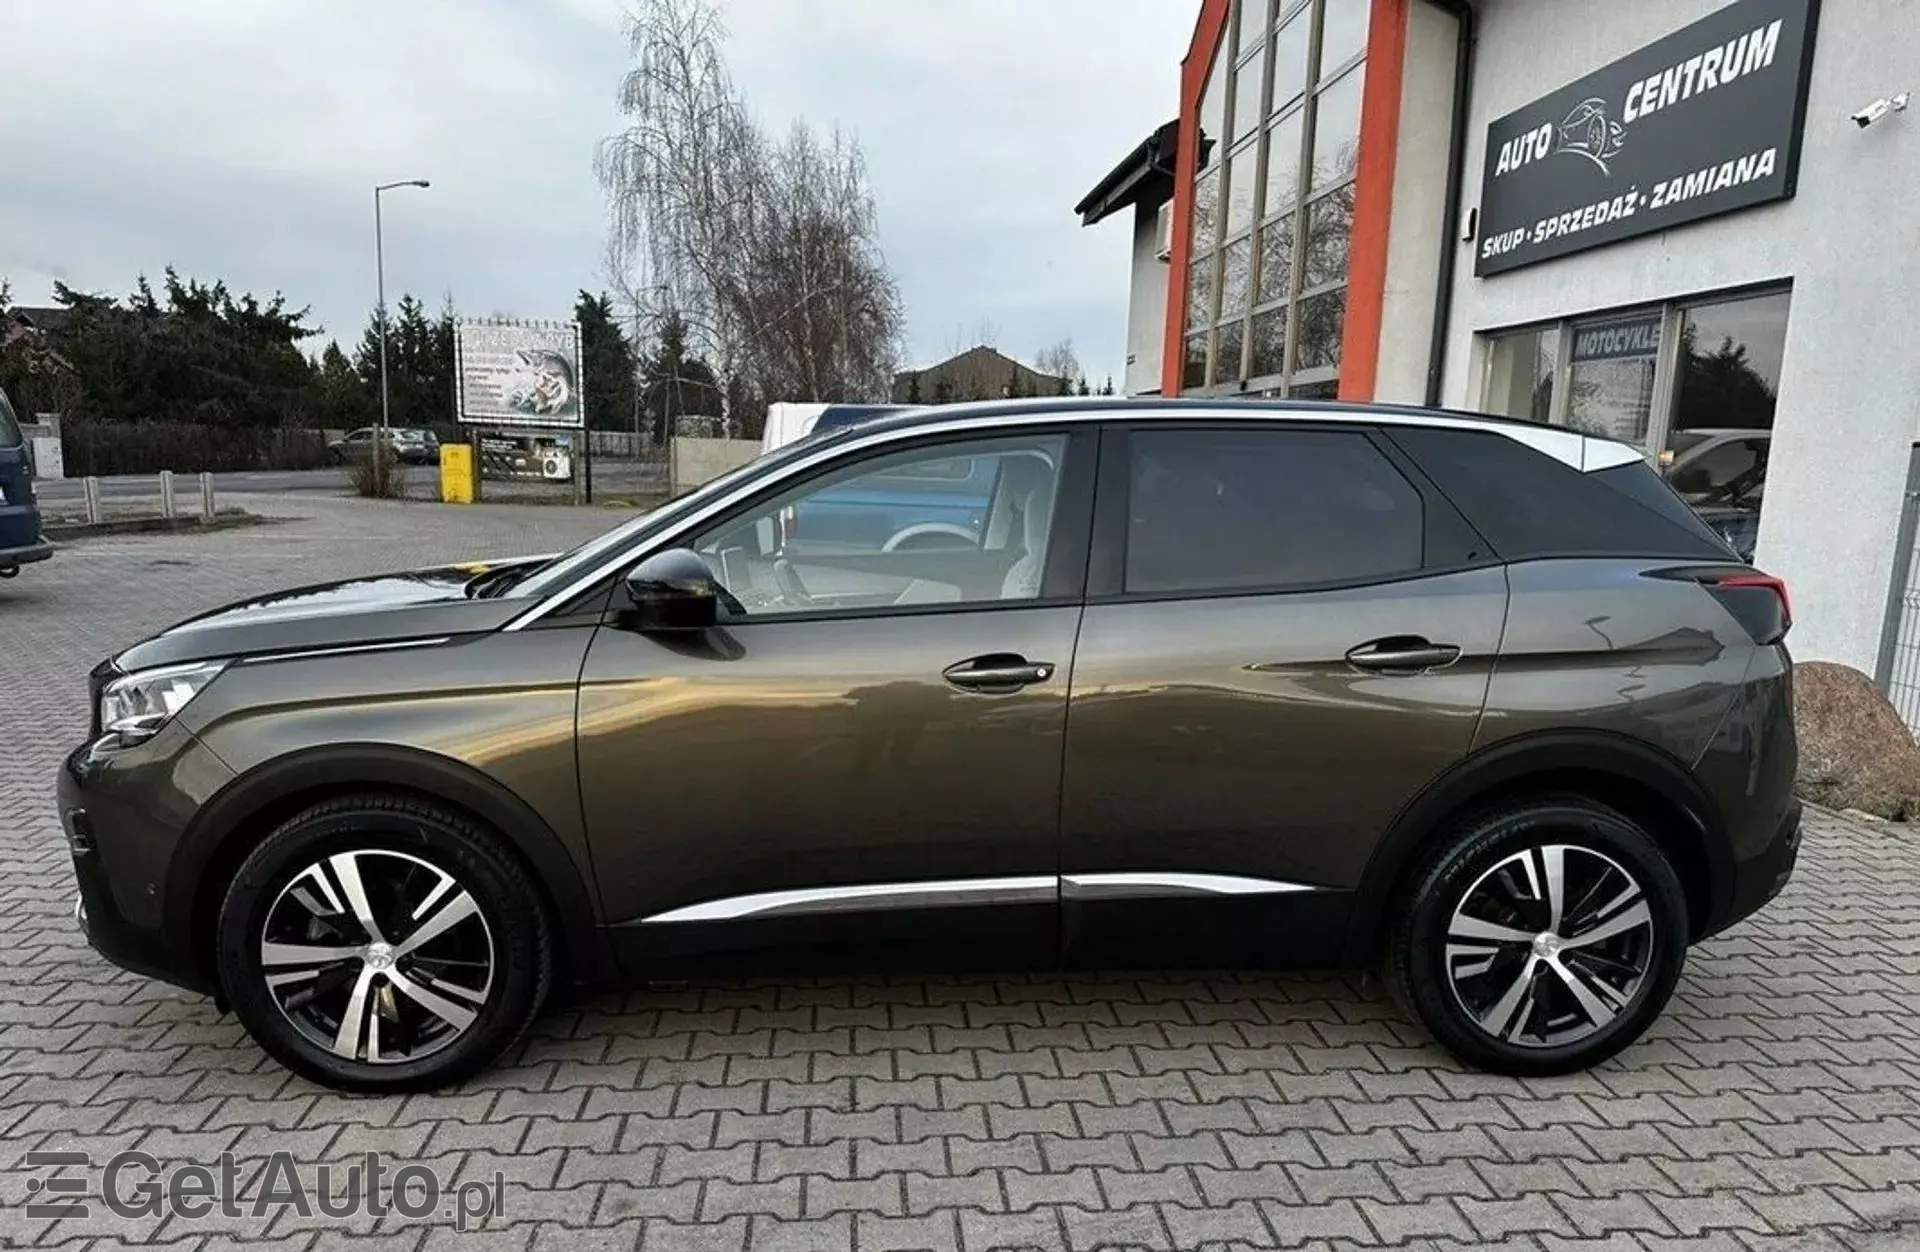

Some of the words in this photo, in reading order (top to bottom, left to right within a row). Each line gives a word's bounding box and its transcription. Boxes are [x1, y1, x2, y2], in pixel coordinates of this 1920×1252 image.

[1495, 123, 1553, 177] AUTO
[1623, 19, 1784, 124] CENTRUM
[1481, 227, 1524, 260] SKUP
[1531, 184, 1638, 244] SPRZEDAŻ
[1650, 147, 1777, 210] ZAMIANA
[1576, 323, 1660, 356] MOTOCYKLE
